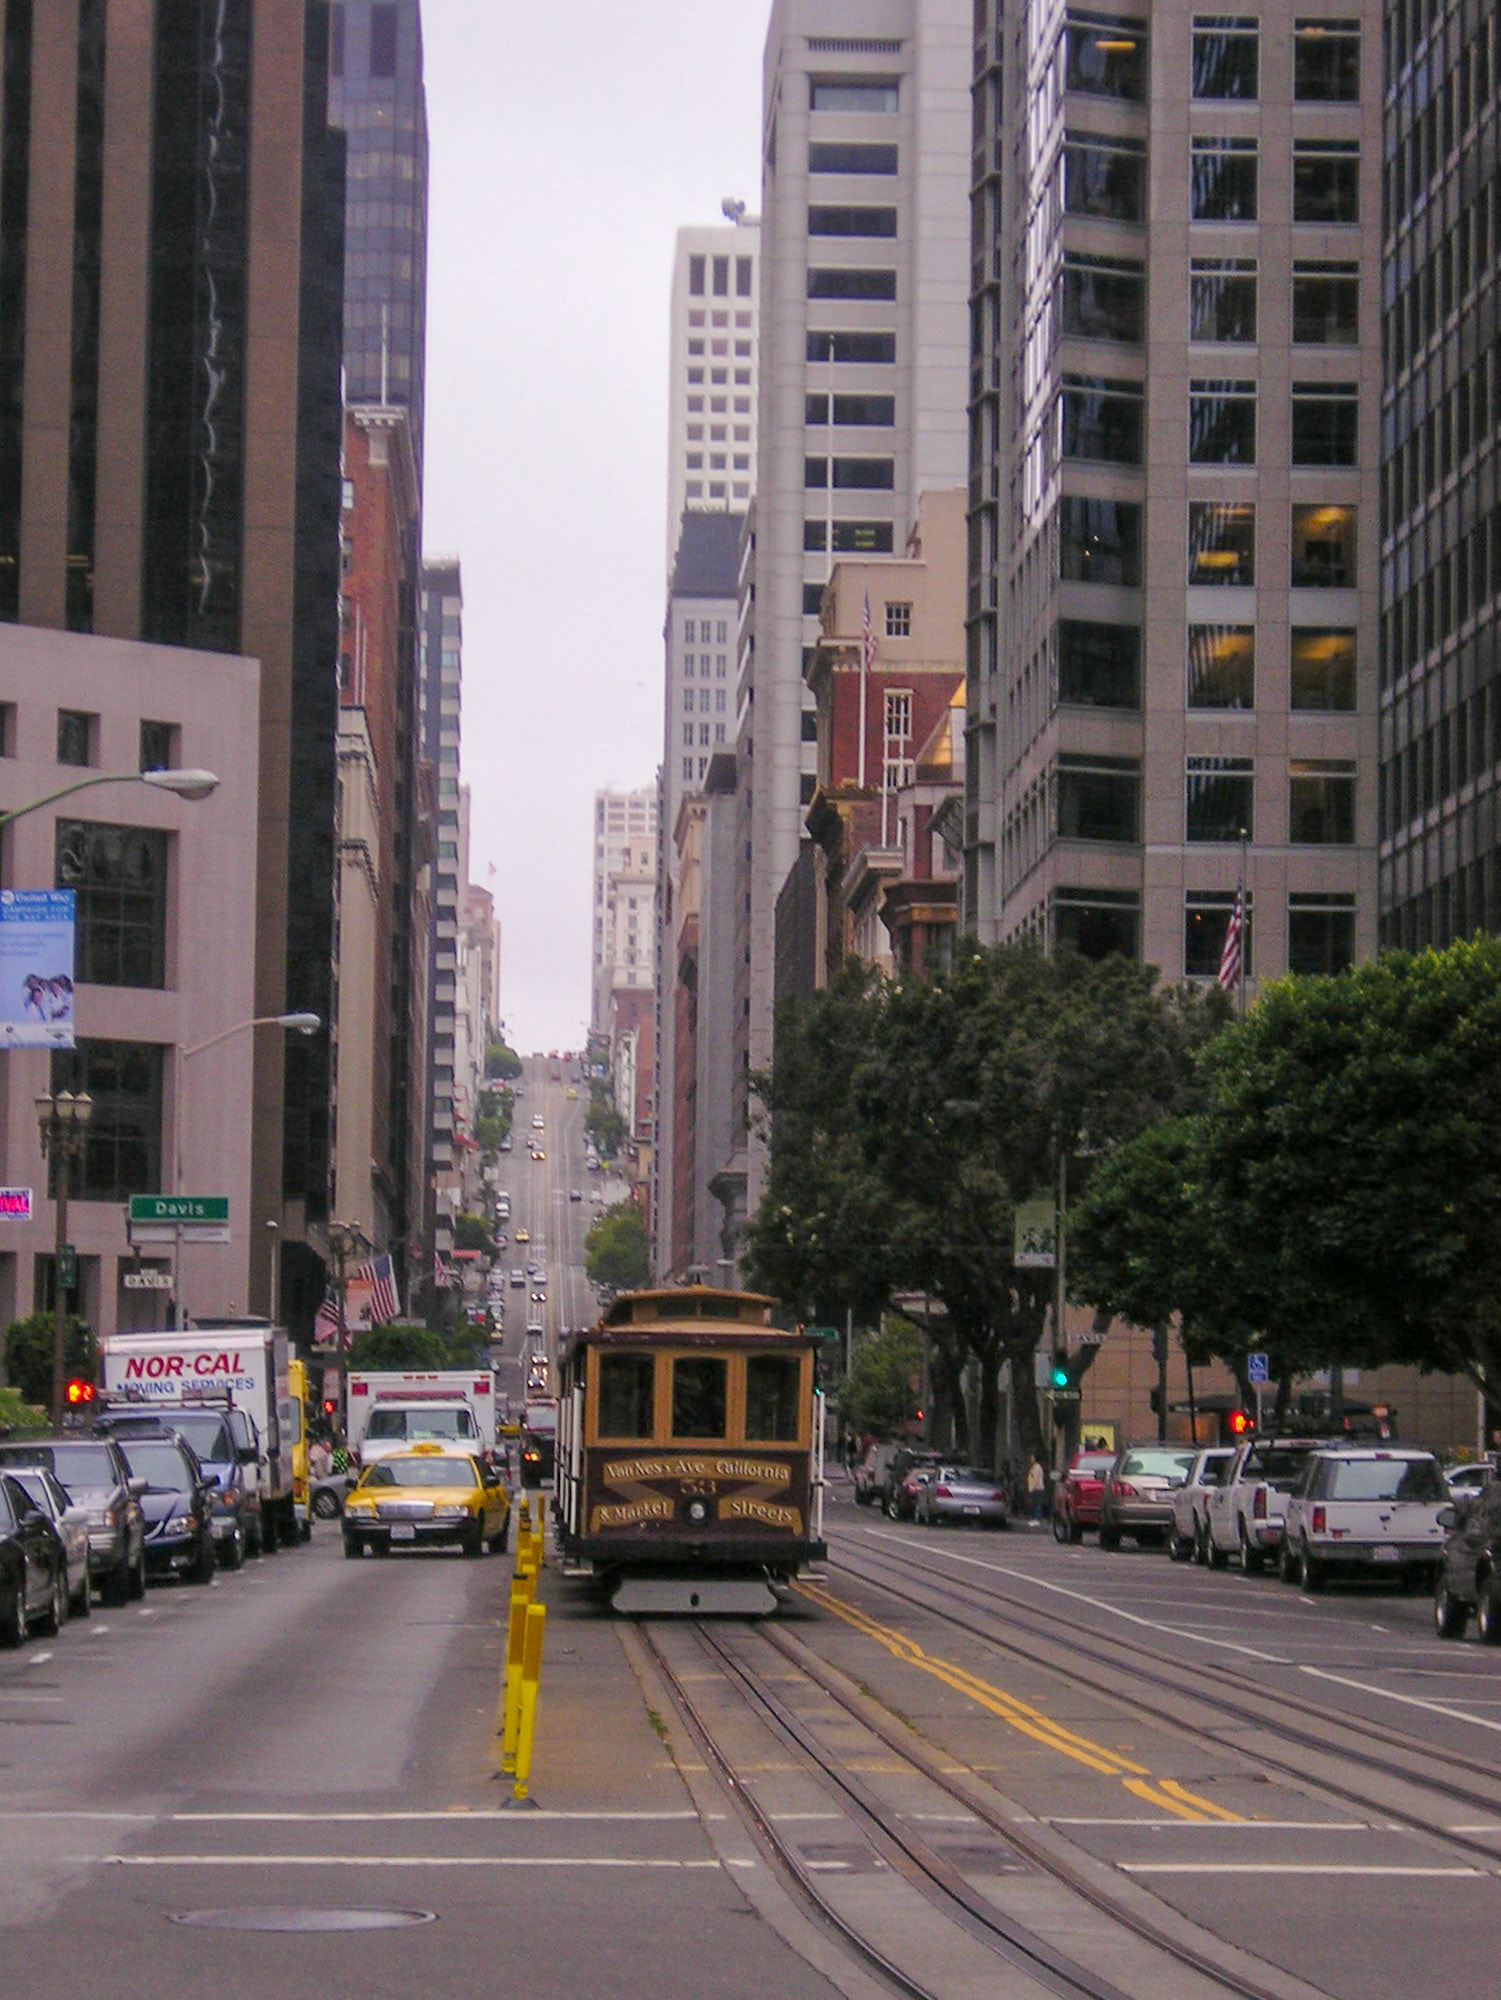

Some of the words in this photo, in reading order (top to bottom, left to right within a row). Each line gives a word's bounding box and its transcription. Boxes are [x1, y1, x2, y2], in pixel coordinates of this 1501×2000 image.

[15, 892, 48, 903] United
[155, 1200, 204, 1215] Davis
[129, 1276, 169, 1286] DAVIS
[126, 1352, 245, 1379] NOR-CAL
[117, 1380, 175, 1394] MOVING
[716, 1459, 790, 1481] California
[600, 1506, 611, 1521] &
[615, 1501, 668, 1519] Market
